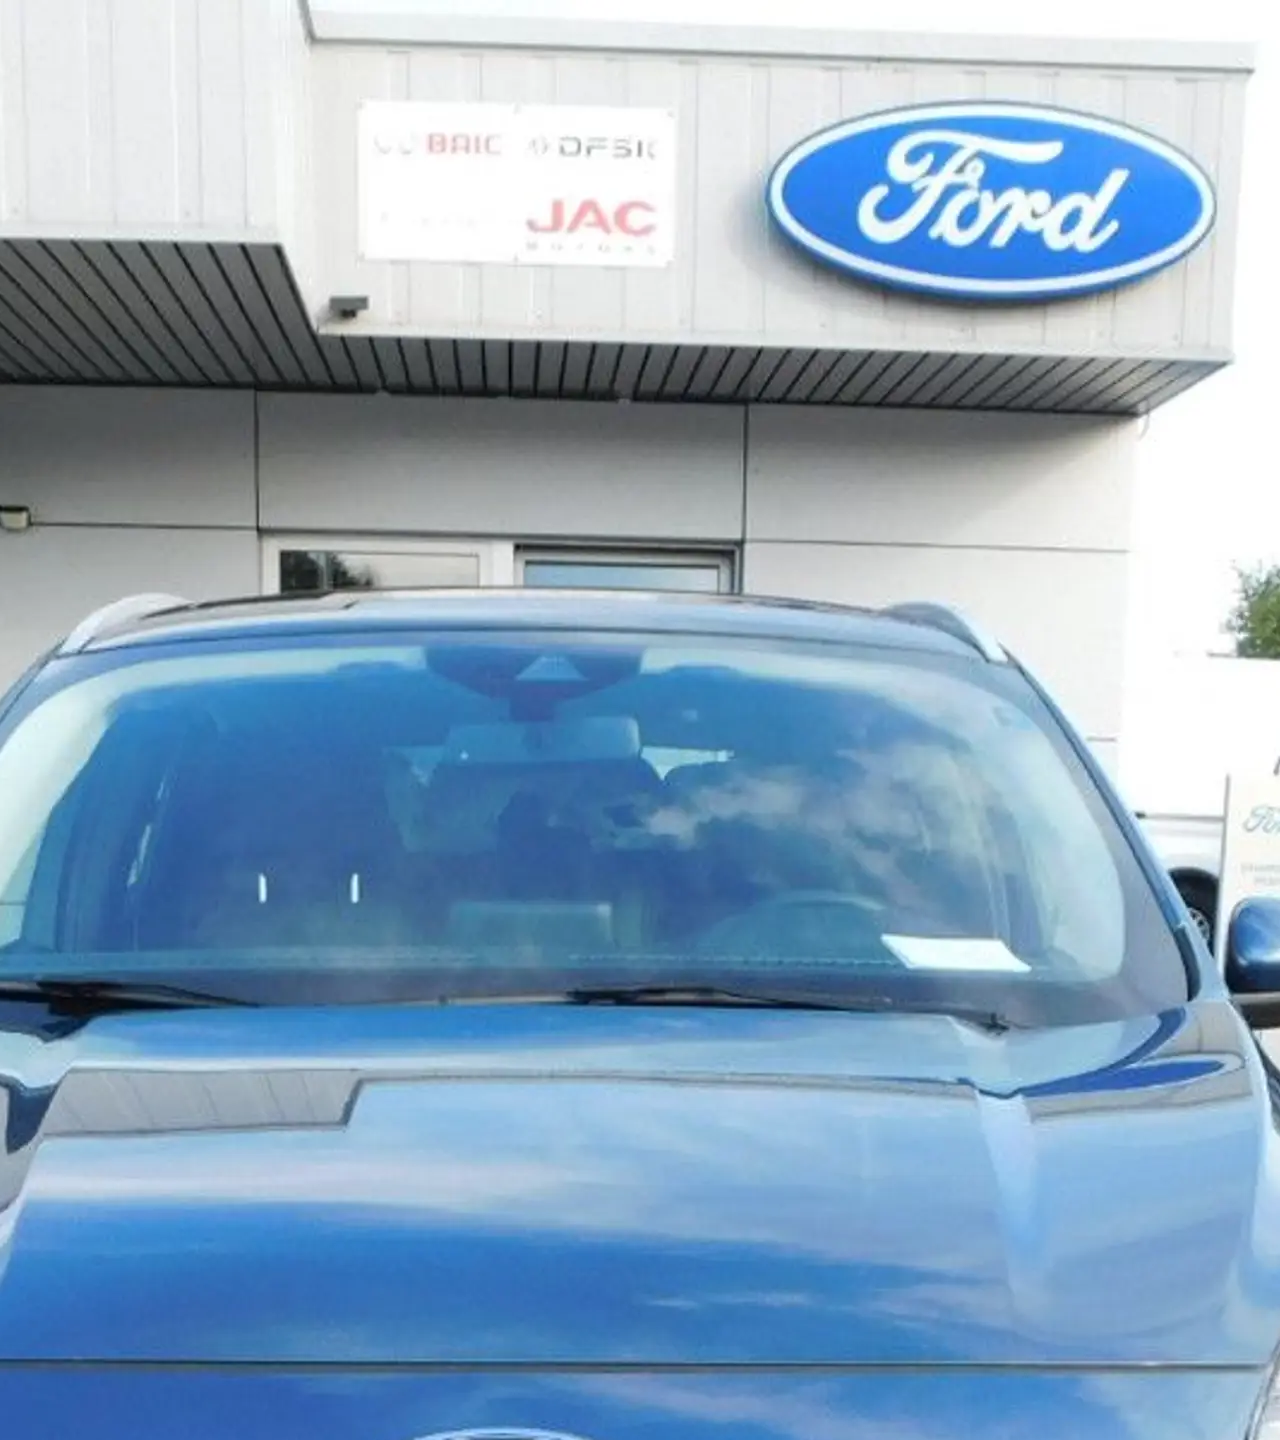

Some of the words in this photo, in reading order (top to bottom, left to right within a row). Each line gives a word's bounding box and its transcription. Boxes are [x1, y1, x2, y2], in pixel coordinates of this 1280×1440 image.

[427, 132, 503, 155] BAIC
[857, 128, 1131, 254] Ford
[525, 197, 658, 237] JAC
